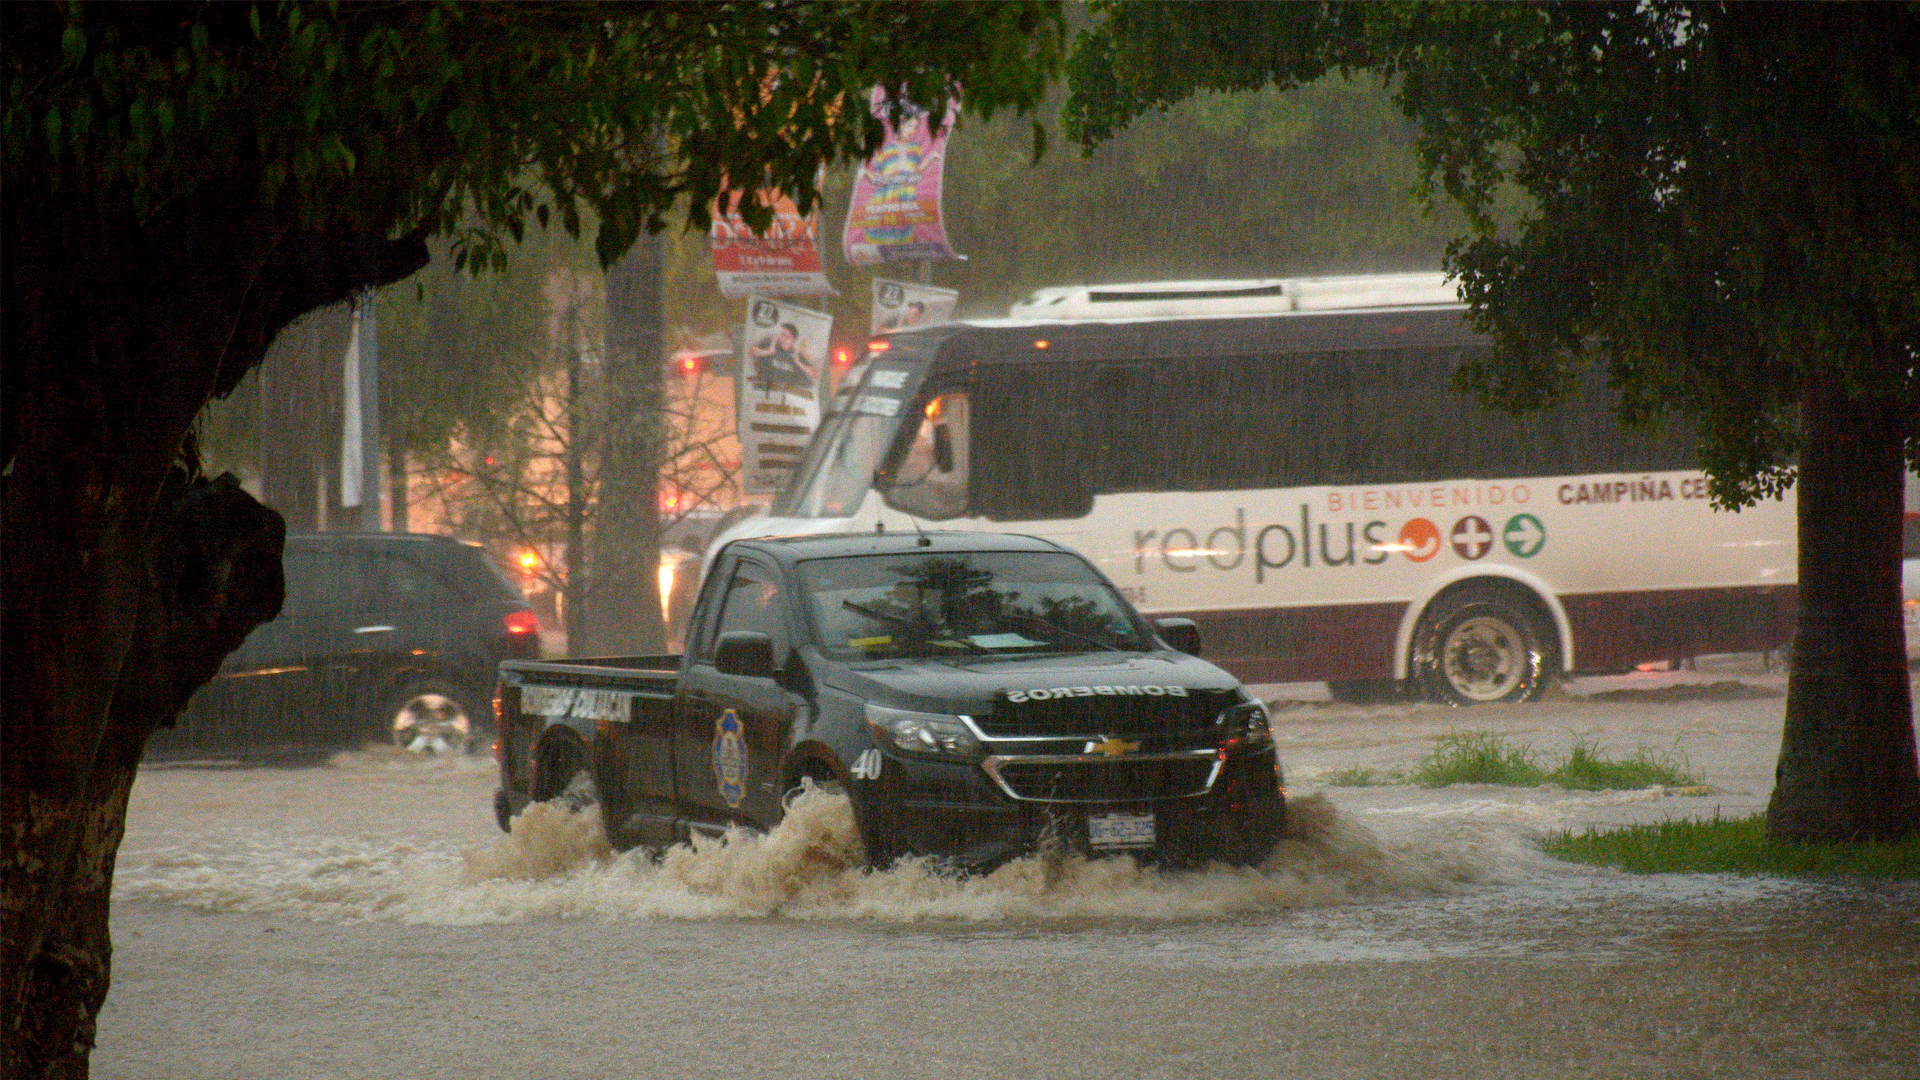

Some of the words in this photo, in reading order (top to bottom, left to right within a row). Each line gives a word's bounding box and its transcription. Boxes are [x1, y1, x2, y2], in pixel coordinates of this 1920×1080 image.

[1327, 484, 1532, 512] BIENVENIDO
[1558, 475, 1674, 505] CAMPIÑA
[1134, 504, 1391, 584] redplus
[850, 749, 883, 781] 40
